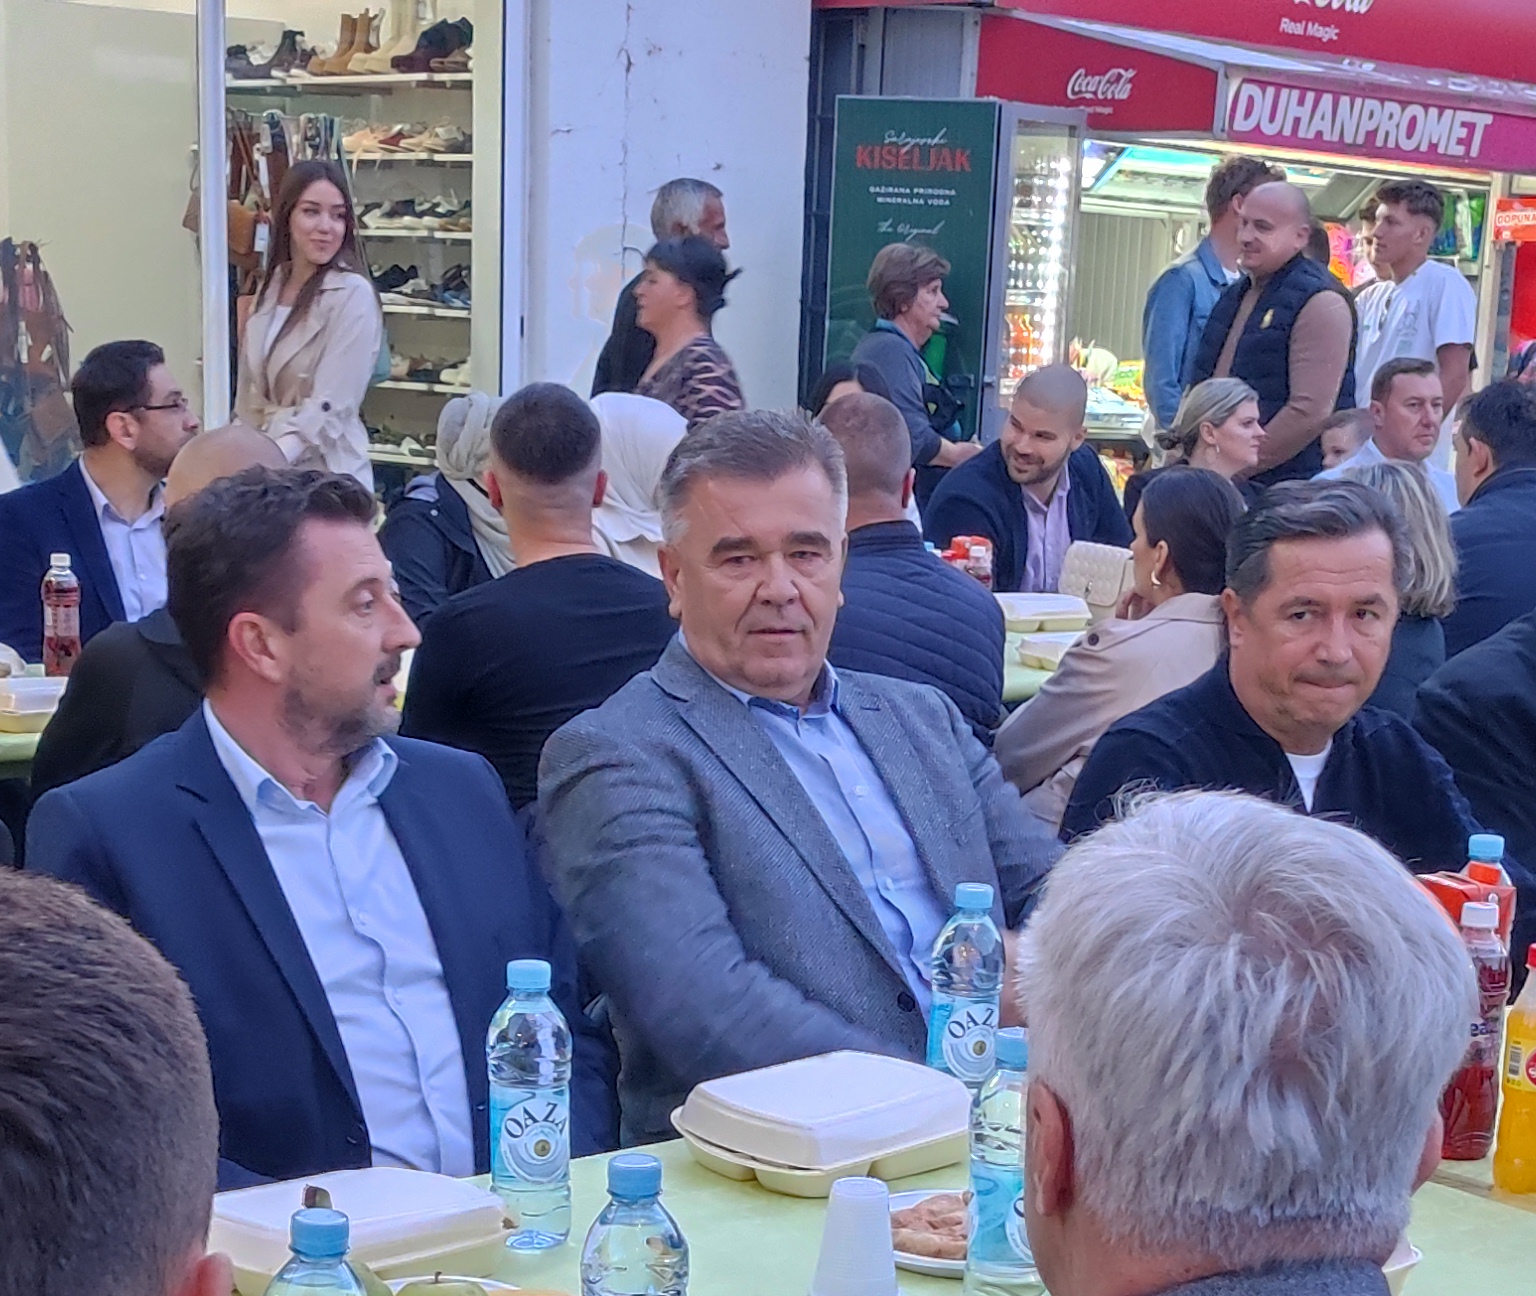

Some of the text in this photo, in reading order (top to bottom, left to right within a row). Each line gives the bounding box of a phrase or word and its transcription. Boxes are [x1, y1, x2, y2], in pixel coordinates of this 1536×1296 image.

[1279, 17, 1340, 42] Real Magic
[1232, 82, 1494, 158] DUHANPROMET
[855, 144, 972, 173] KISELJAK
[876, 196, 951, 206] MINERALNA VODA
[913, 186, 956, 196] PRIRODNA
[947, 1006, 997, 1039] OAZ
[504, 1101, 568, 1139] OAZA
